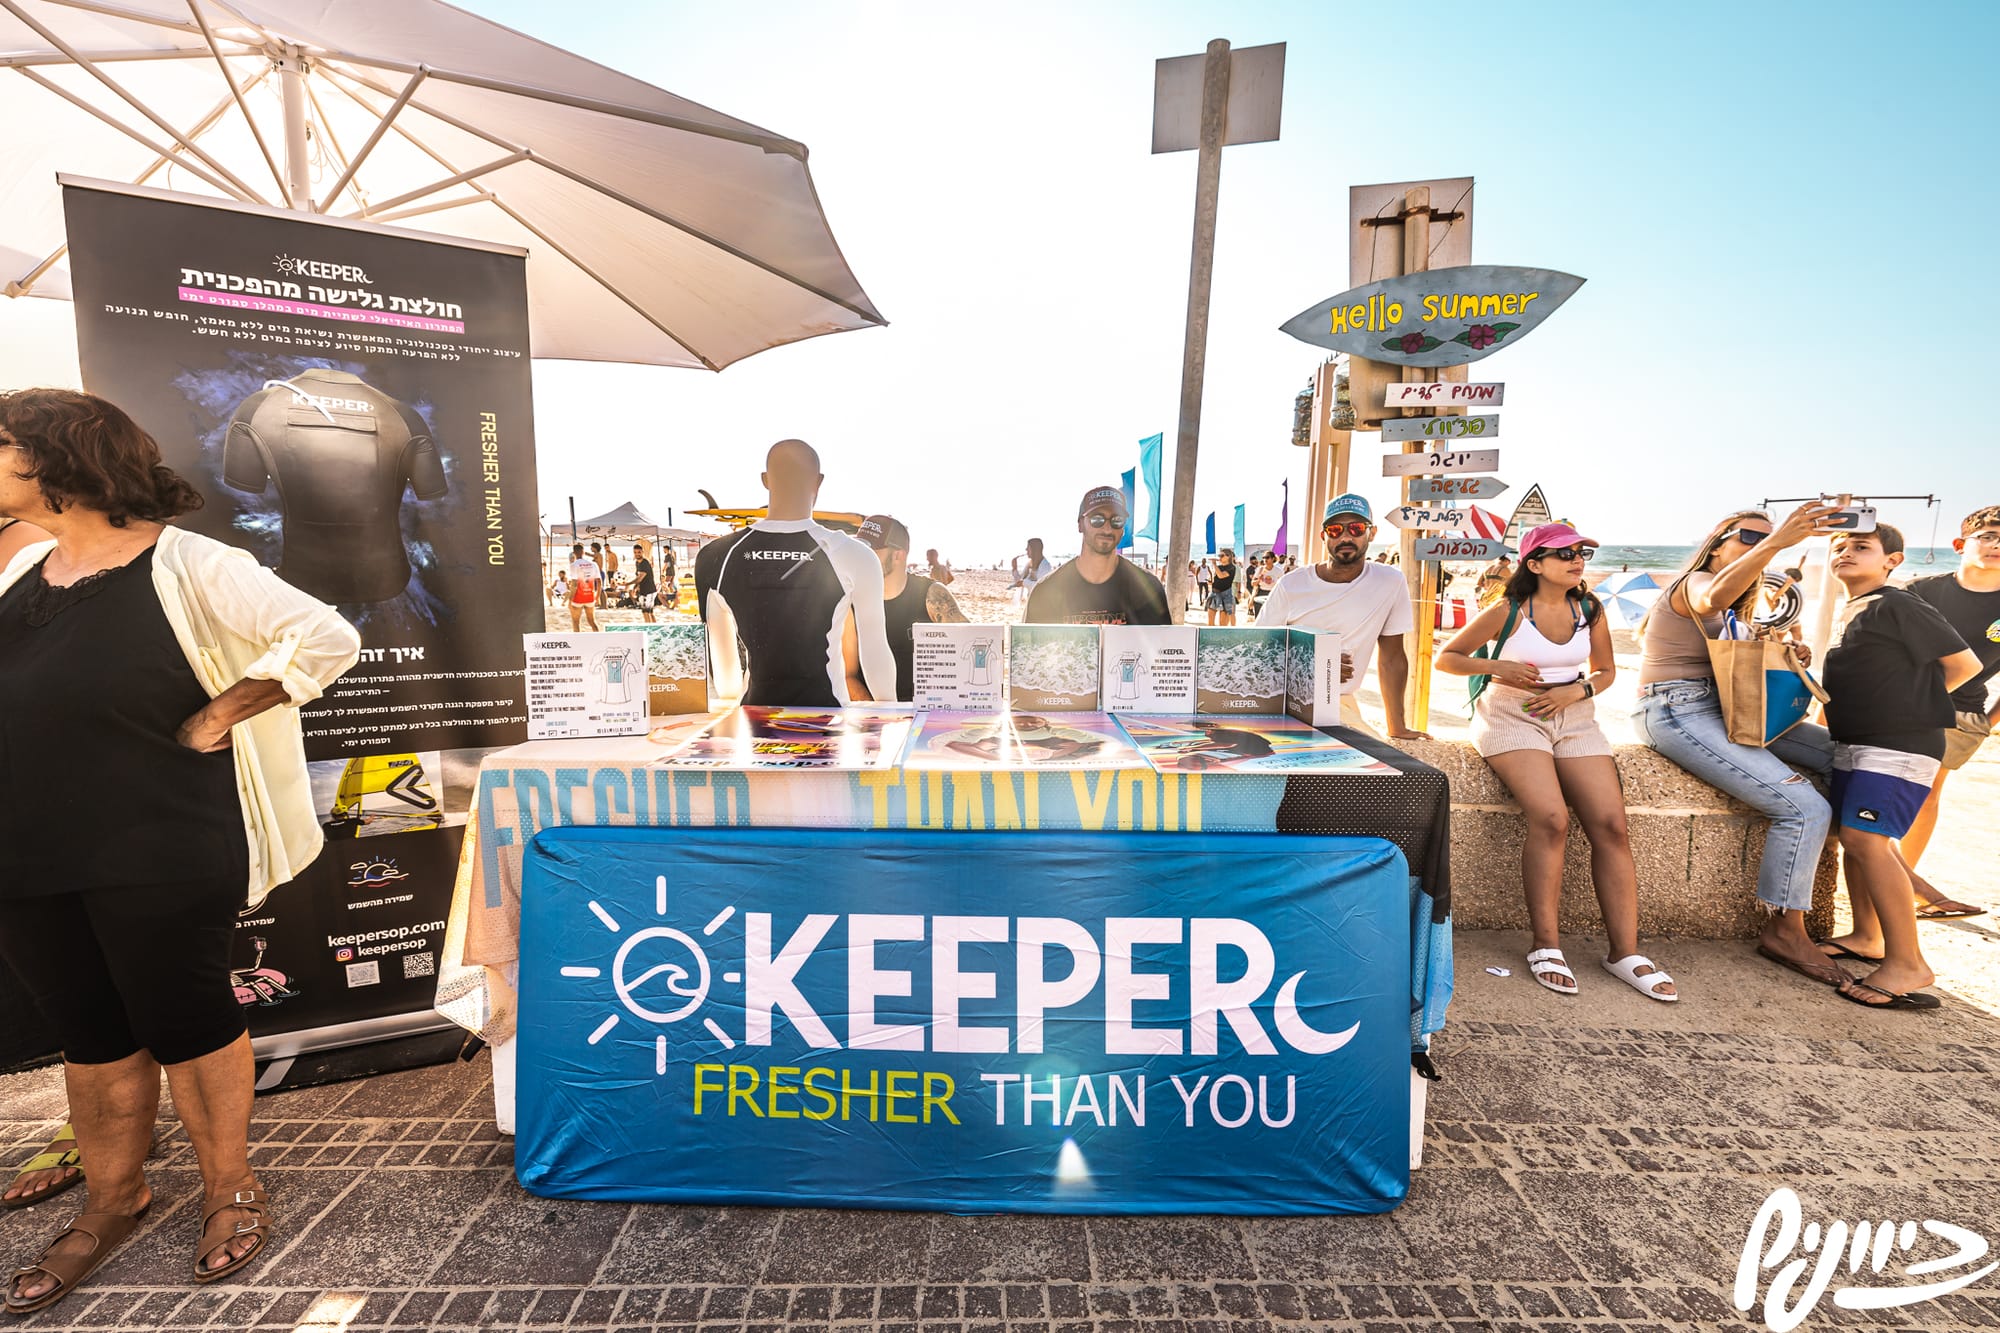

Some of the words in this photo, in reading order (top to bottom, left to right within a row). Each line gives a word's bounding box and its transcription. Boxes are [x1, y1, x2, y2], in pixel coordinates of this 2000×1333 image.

[296, 258, 363, 283] KEEPER
[180, 267, 301, 299] מהפכנית
[182, 292, 204, 301] ימי
[308, 285, 384, 309] גלישה
[208, 296, 249, 308] ספורט
[253, 301, 292, 313] במהלך
[105, 304, 149, 316] תנועה
[296, 307, 319, 317] מים
[389, 296, 462, 319] חולצת
[153, 310, 189, 321] חופש
[323, 309, 366, 321] לשתיית
[1330, 293, 1404, 334] Hello
[240, 321, 263, 330] ללא
[369, 315, 421, 328] האידיאלי
[192, 327, 229, 337] חשש.
[268, 323, 291, 333] מים
[425, 321, 463, 333] הפתרון
[233, 330, 256, 340] ללא
[295, 327, 333, 338] נשיאת
[261, 334, 291, 344] במים
[295, 338, 331, 348] לציפה
[337, 332, 391, 345] המאפשרת
[335, 342, 361, 351] סיוע
[396, 338, 455, 351] בטכנולוגיה
[365, 345, 398, 355] ומתקן
[402, 349, 438, 359] הפרעה
[459, 345, 490, 355] ייחודי
[493, 349, 520, 358] עיצוב
[440, 353, 460, 361] ללא
[1401, 383, 1442, 400] ילדים
[1452, 385, 1496, 400] מתחם
[480, 411, 499, 483] FRESHER
[1430, 453, 1471, 467] יוגה
[1430, 478, 1480, 494] גלישה
[485, 487, 502, 530] THAN
[1432, 509, 1464, 527] קבלת
[488, 534, 504, 566] YOU
[1427, 541, 1488, 558] הופעות
[752, 550, 810, 561] KEEPER
[541, 641, 568, 649] KEEPER
[360, 648, 385, 662] זה
[389, 646, 425, 663] איך
[337, 677, 368, 685] מושלם
[370, 675, 395, 684] פתרון
[423, 672, 455, 680] חדשנית
[390, 704, 418, 713] השמש
[419, 702, 443, 711] מקרני
[445, 701, 464, 709] הגנה
[465, 700, 493, 709] מספקת
[1230, 699, 1256, 708] KEEPER
[300, 709, 332, 719] לשתות
[334, 708, 345, 717] לך
[346, 707, 388, 716] ומאפשרת
[425, 721, 440, 729] בכל
[442, 719, 471, 728] החולצה
[486, 716, 509, 725] להפוך
[358, 725, 378, 734] סיוע
[380, 723, 407, 732] למתקן
[408, 722, 424, 730] רגע
[306, 729, 327, 737] והיא
[329, 727, 356, 736] לציפה
[360, 737, 391, 746] וספורט
[347, 898, 383, 910] מהשמש
[384, 893, 414, 905] שמירה
[243, 917, 276, 927] שמירה
[327, 919, 446, 948] keepersop.com
[357, 938, 427, 957] keepersop
[744, 912, 1276, 1056] KEEPER
[693, 1063, 961, 1125] FRESHER
[980, 1072, 1147, 1127] THAN
[1170, 1074, 1296, 1128] YOU
